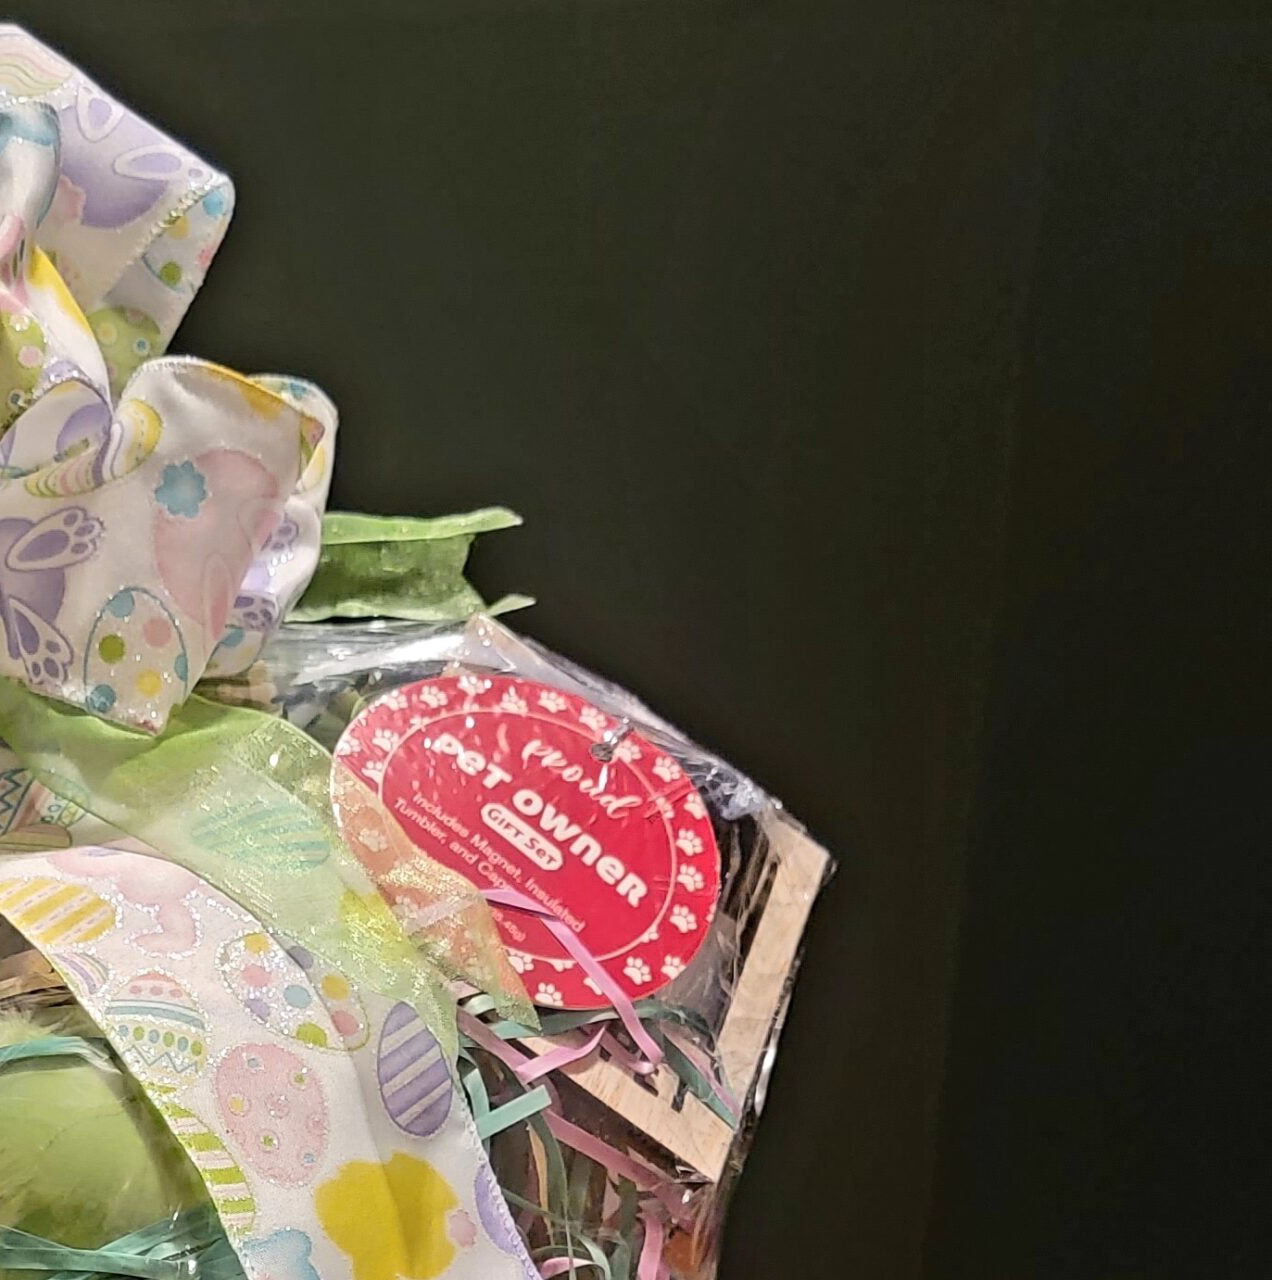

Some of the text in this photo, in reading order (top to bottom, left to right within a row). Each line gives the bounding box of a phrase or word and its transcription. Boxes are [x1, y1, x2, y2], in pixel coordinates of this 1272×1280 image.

[412, 792, 470, 840] Includes
[525, 877, 586, 933] Insulated
[449, 841, 479, 865] and
